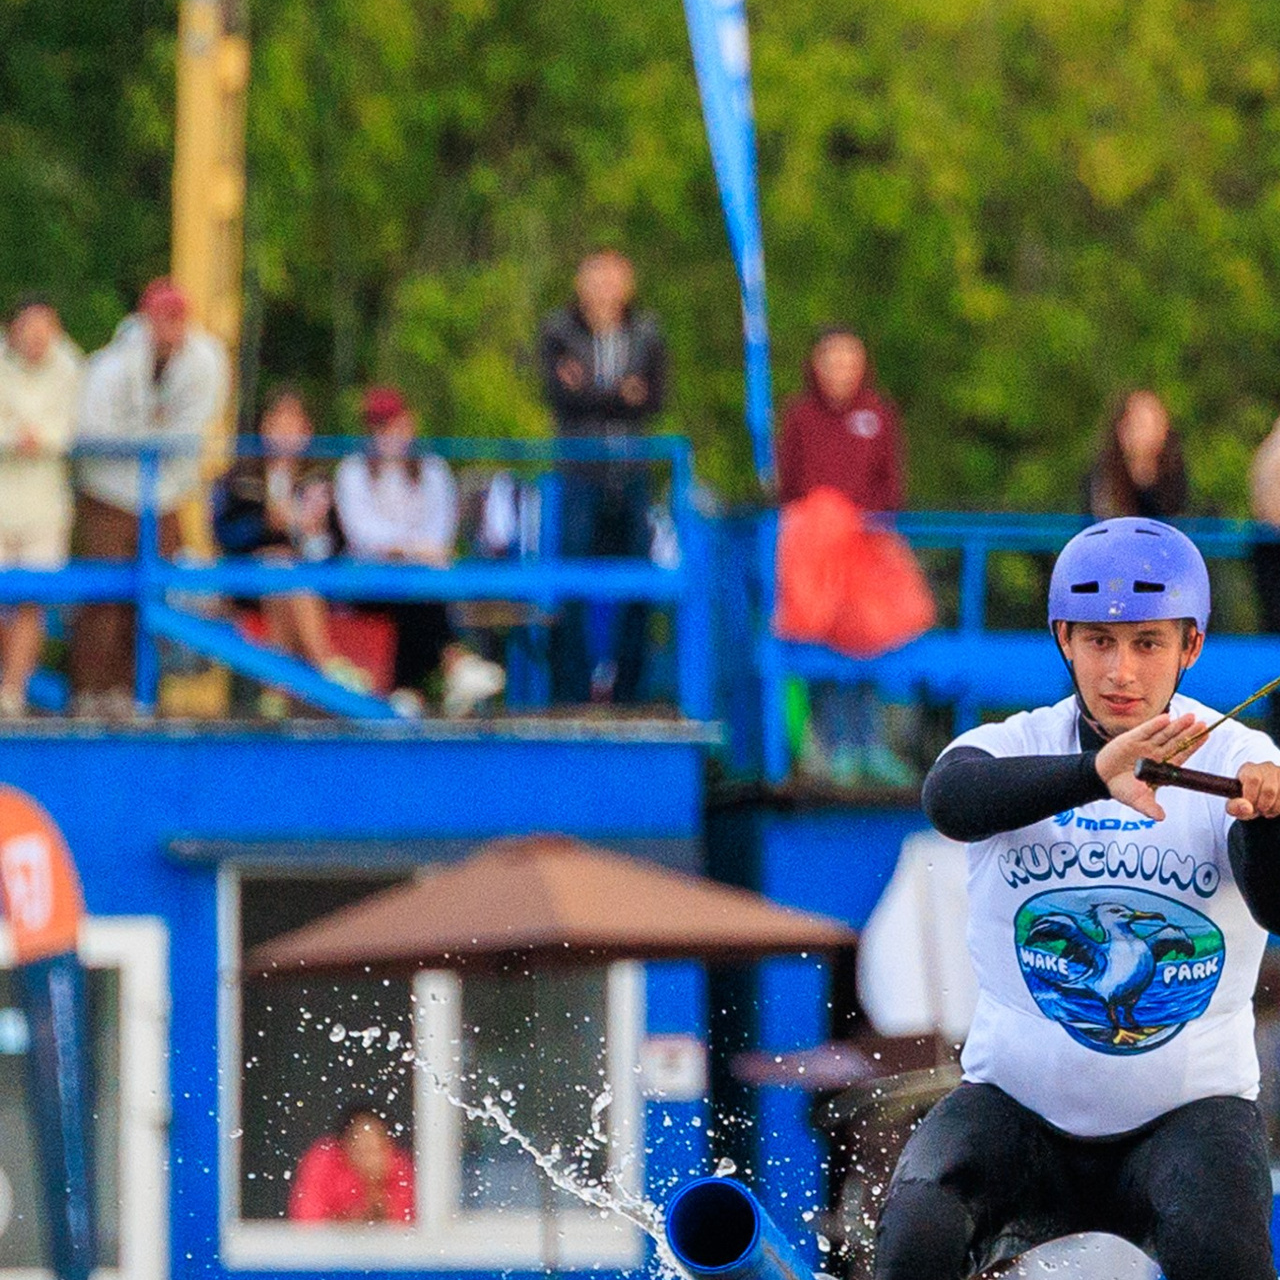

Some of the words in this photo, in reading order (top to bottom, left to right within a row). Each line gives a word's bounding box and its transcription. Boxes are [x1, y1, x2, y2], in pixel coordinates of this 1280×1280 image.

[998, 841, 1221, 898] KUPCHINO
[1019, 947, 1070, 976] WAKE
[1163, 957, 1219, 984] PARK
